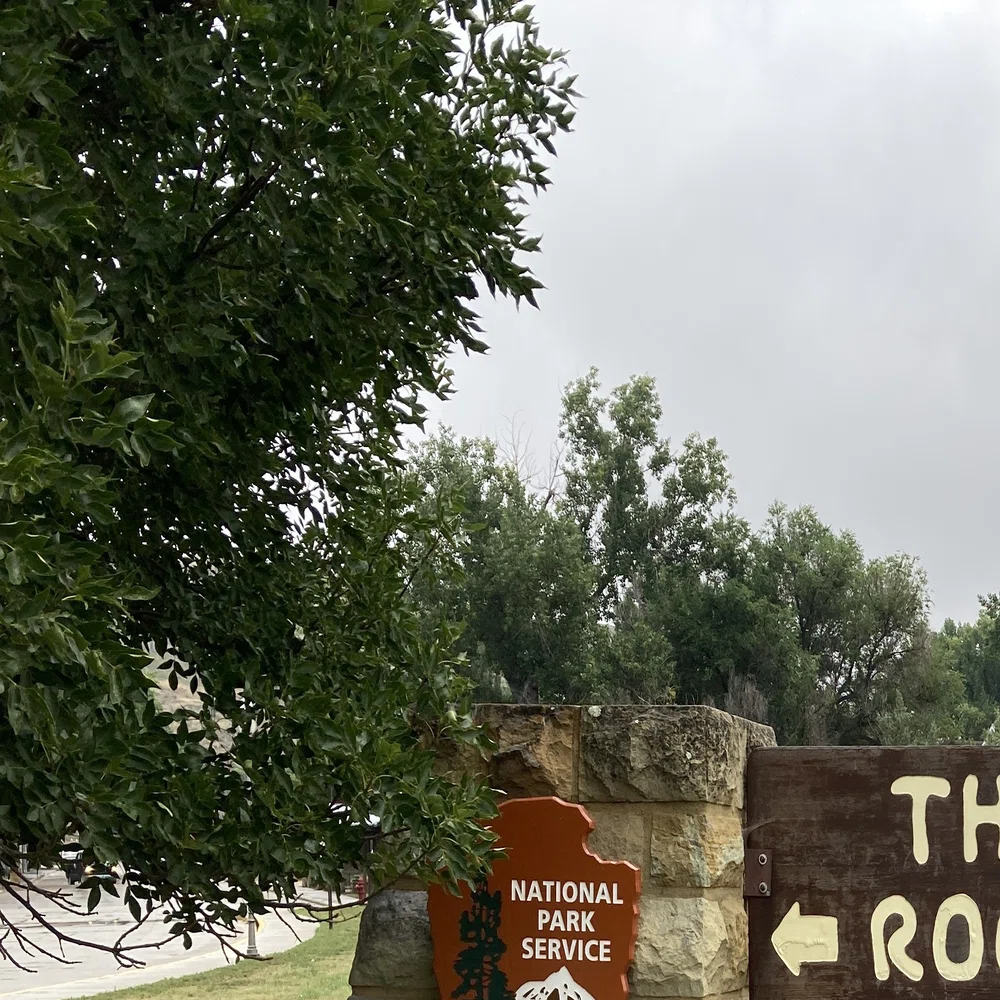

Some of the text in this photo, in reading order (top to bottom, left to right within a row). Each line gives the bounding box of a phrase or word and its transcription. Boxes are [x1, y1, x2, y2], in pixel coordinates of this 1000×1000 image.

[511, 879, 624, 905] NATIONAL
[537, 909, 596, 933] PARK
[521, 937, 612, 962] SERVICE
